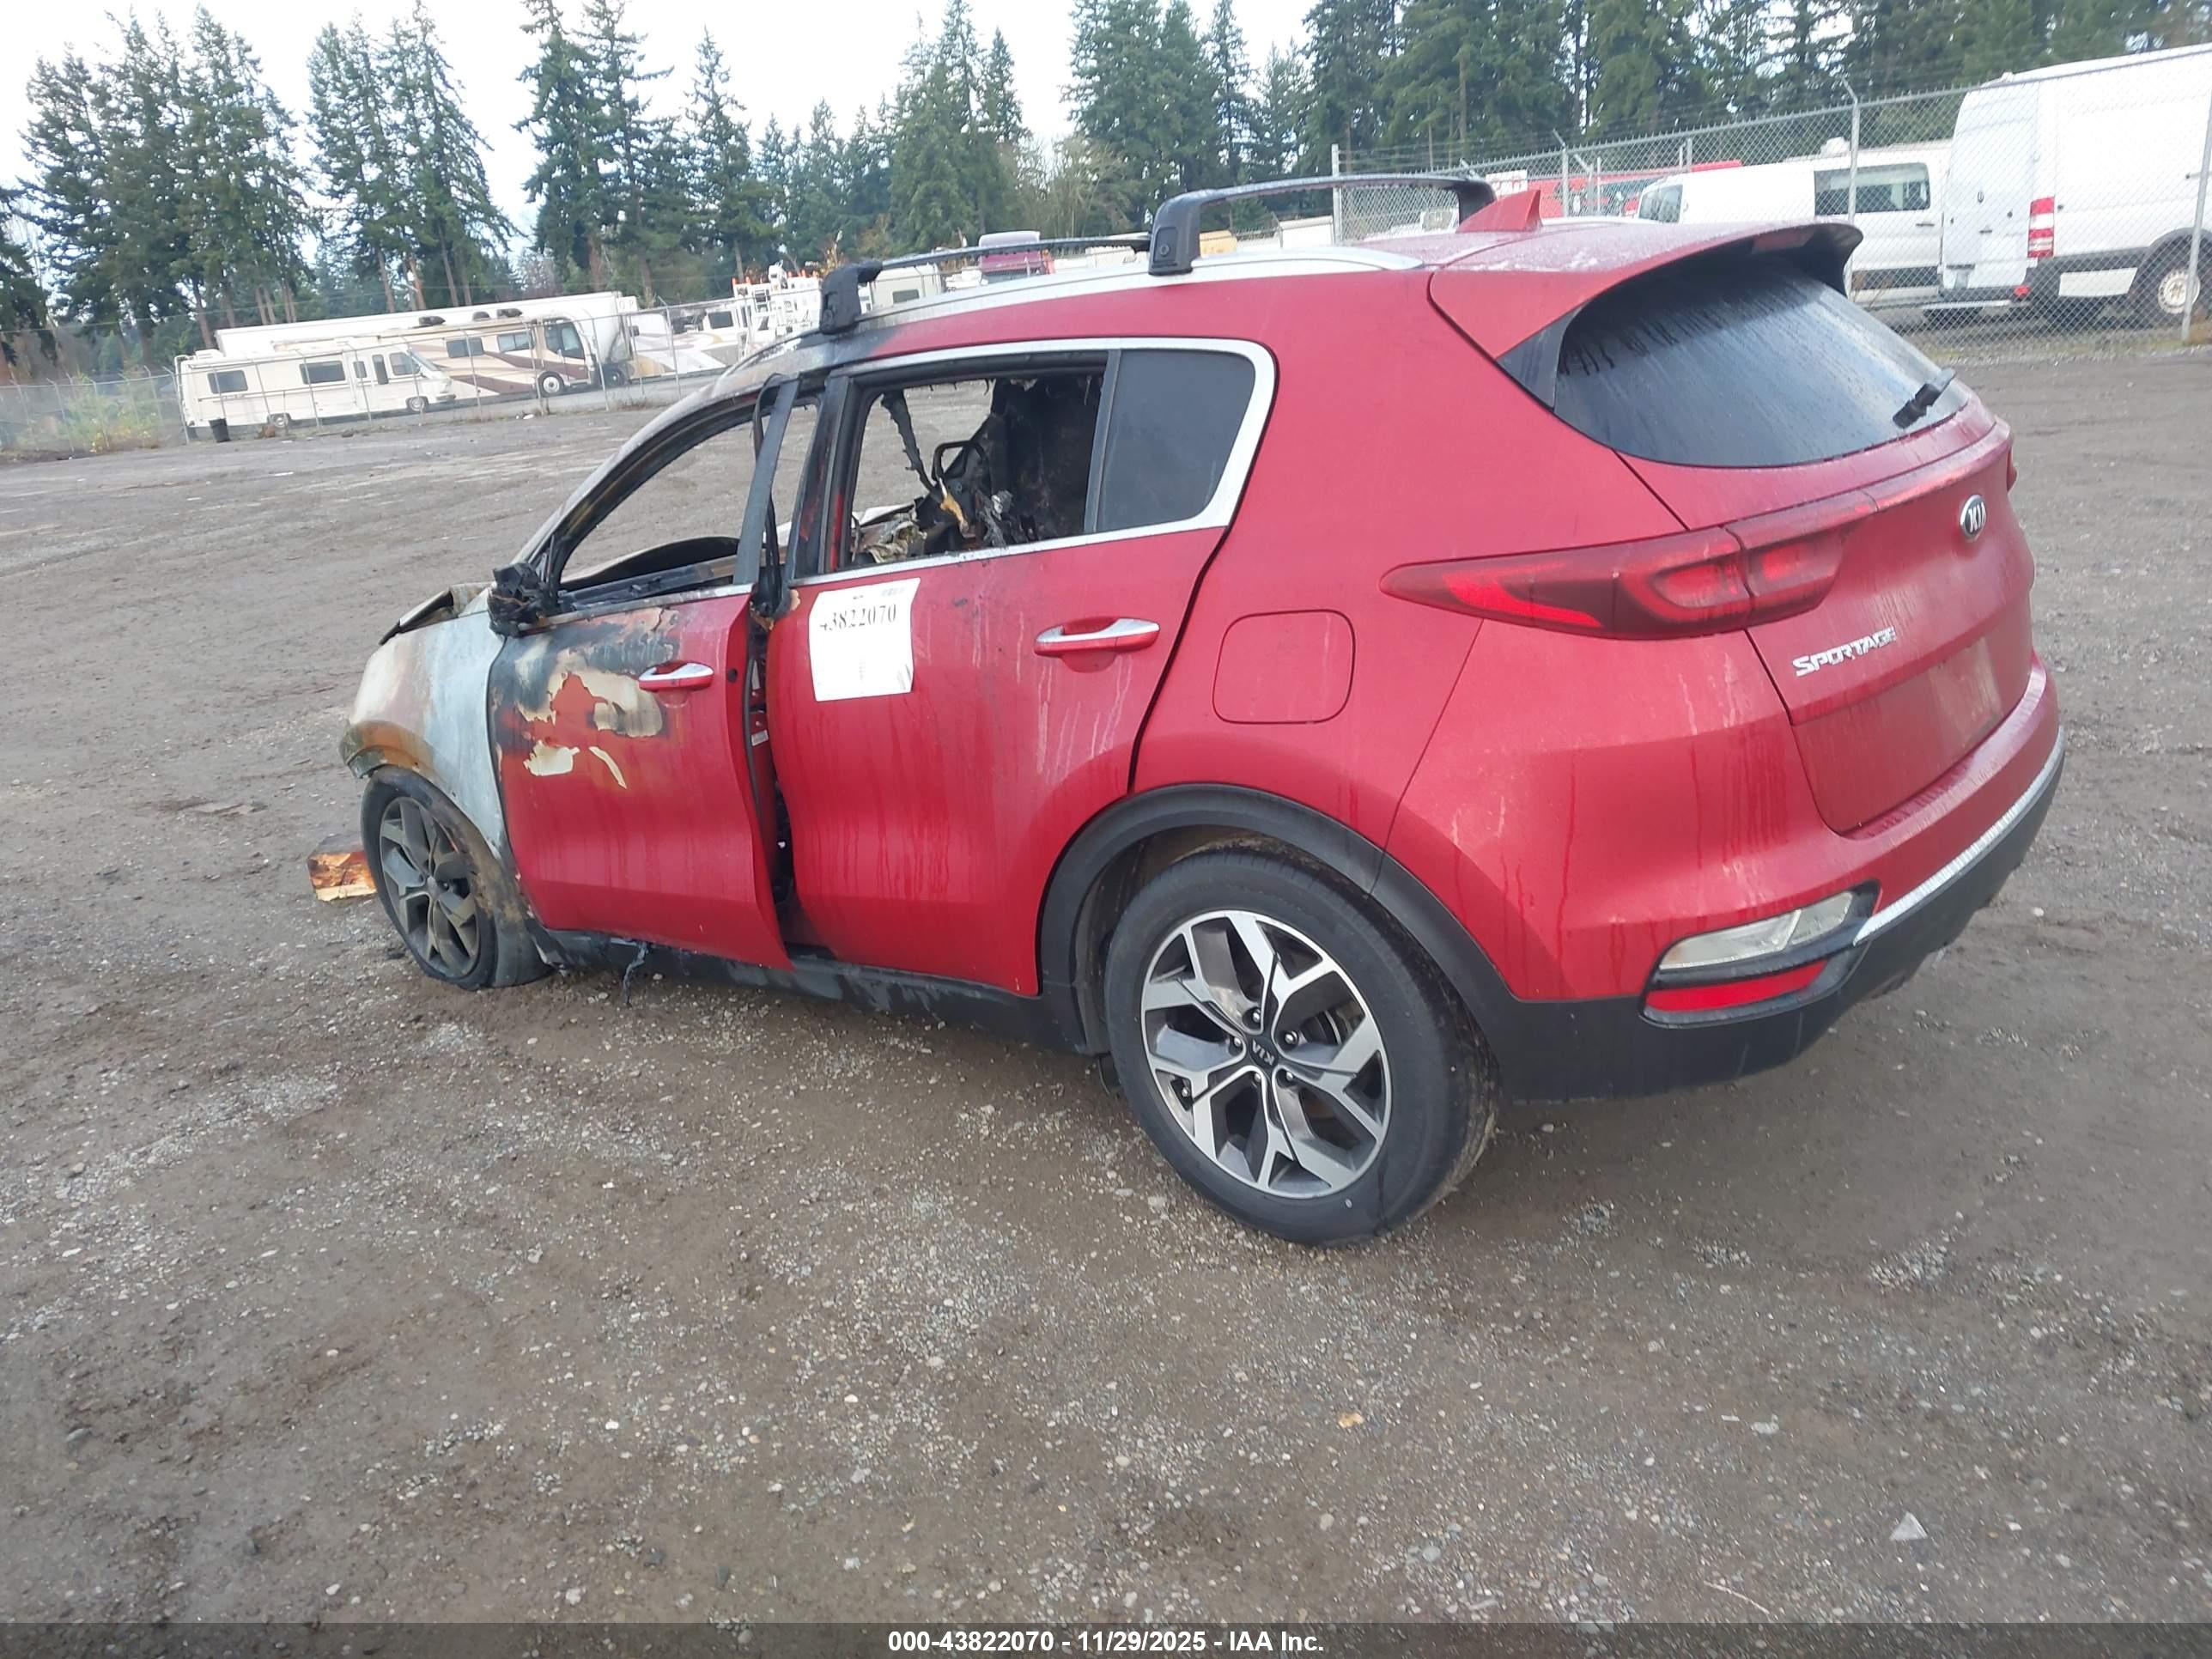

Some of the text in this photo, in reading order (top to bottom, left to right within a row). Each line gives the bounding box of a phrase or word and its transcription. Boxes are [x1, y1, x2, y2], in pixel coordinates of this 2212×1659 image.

[1968, 501, 1986, 532] KIA
[1792, 626, 1897, 677] SPORTAGE
[1252, 1038, 1275, 1066] KIA
